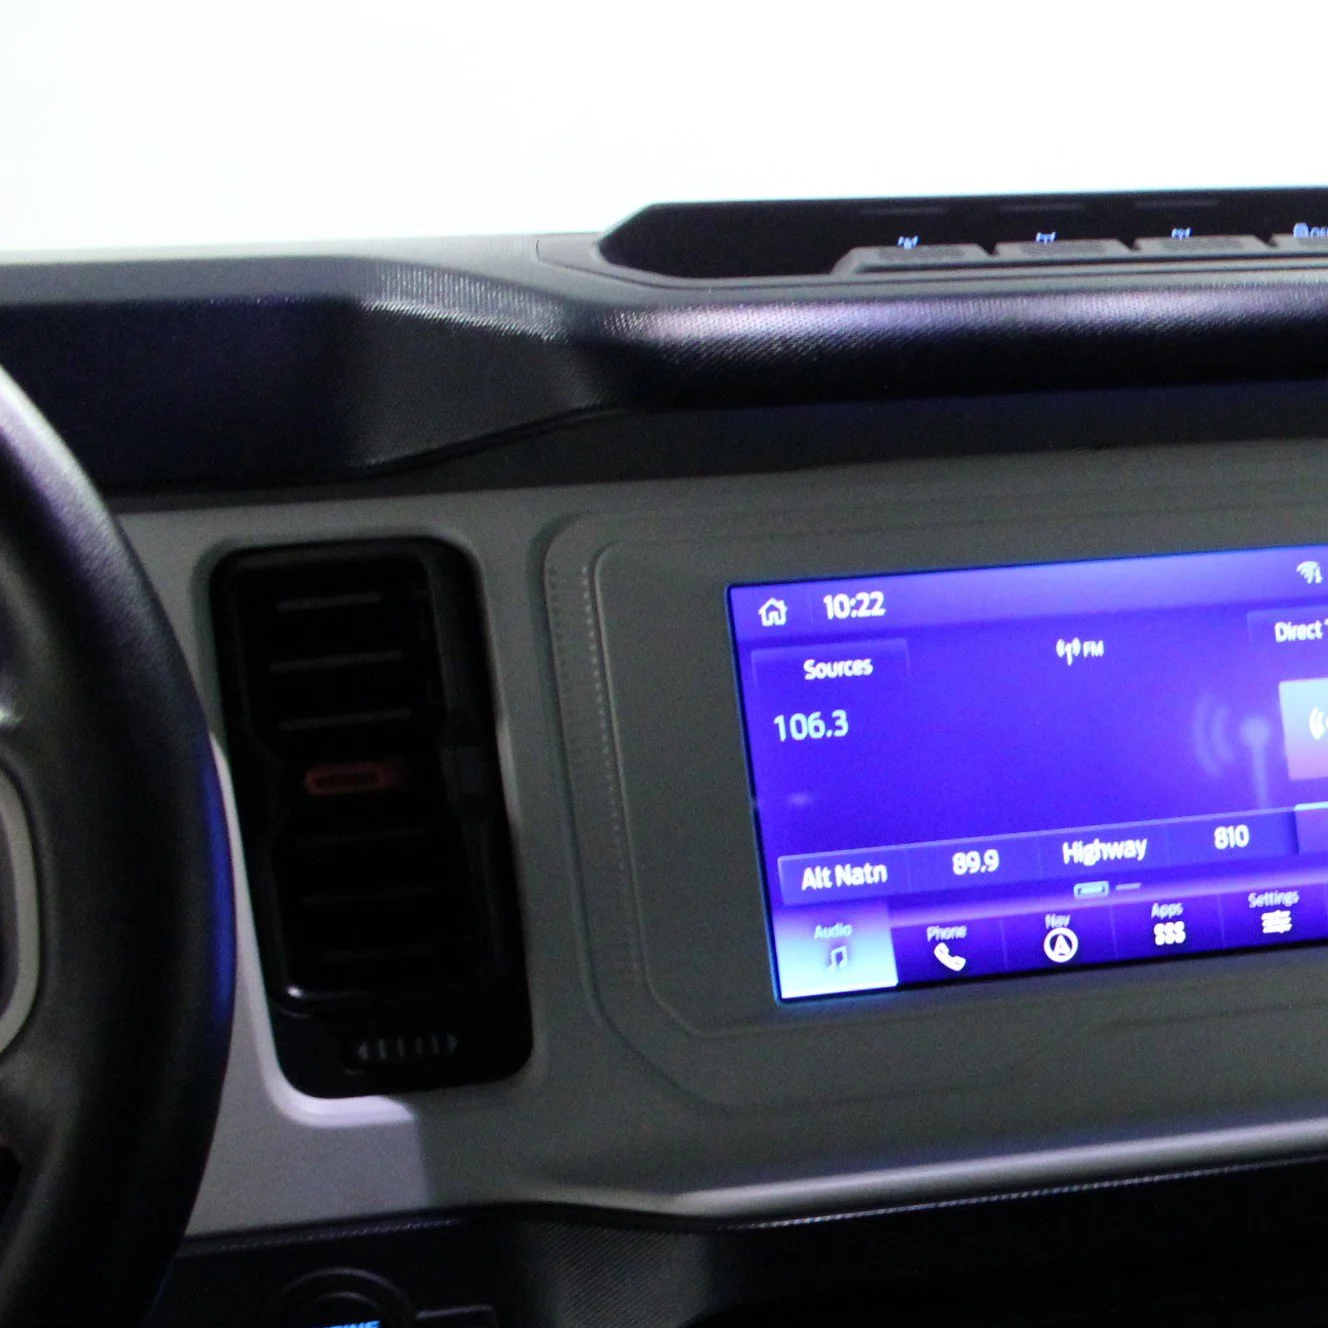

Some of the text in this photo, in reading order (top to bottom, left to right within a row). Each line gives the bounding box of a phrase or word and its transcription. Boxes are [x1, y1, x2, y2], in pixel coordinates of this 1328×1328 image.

[823, 591, 886, 620] 10:22
[1274, 620, 1323, 642] Direct
[1083, 640, 1104, 657] FM
[803, 658, 873, 680] Sources
[773, 709, 849, 742] 106.3
[1213, 824, 1250, 850] 810
[952, 849, 999, 876] 89.9
[1062, 837, 1148, 866] Highway
[801, 862, 888, 891] Alt Natn
[1151, 902, 1184, 920] Apps
[1248, 889, 1300, 911] Settings
[814, 922, 853, 940] Audio
[1044, 913, 1071, 930] Nav
[926, 924, 968, 942] Phone
